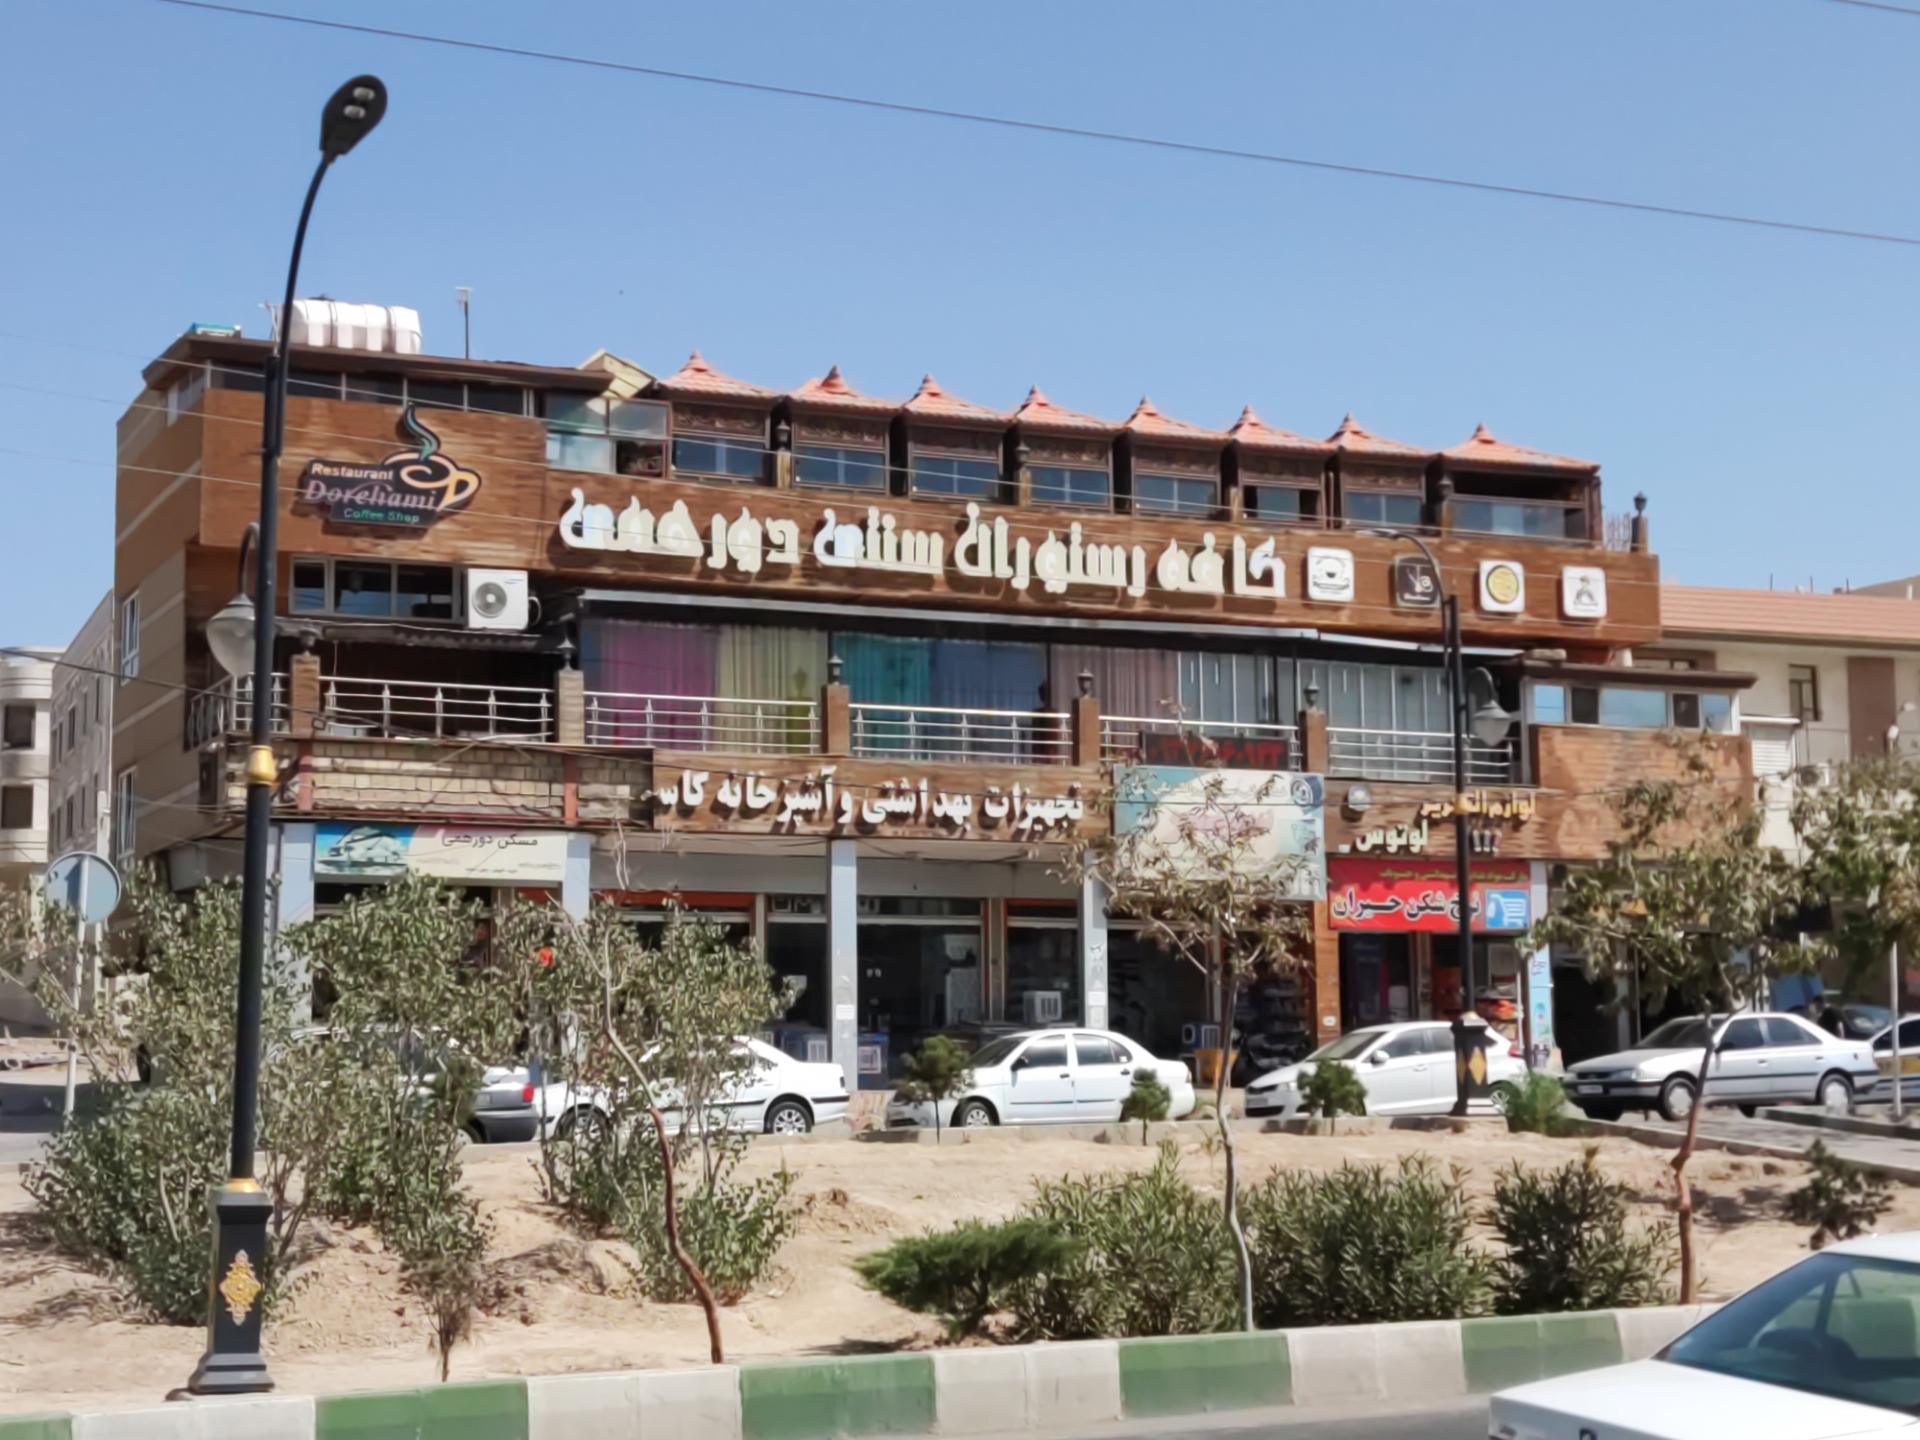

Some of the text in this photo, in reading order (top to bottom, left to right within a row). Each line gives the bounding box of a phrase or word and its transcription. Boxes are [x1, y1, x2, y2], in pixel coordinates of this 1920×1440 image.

[311, 463, 394, 480] Restaurant
[305, 479, 437, 511] Dorehami
[343, 508, 420, 523] Coffee Shop
[954, 501, 1146, 598] رستوران
[1157, 531, 1286, 599] کافه
[717, 764, 837, 827] آشپزخانه
[838, 789, 852, 824] و
[862, 777, 973, 832] بهداشتی
[984, 781, 1084, 832] تجهیزات
[1488, 789, 1536, 822] لوازم
[496, 832, 539, 850] مسکن
[1355, 818, 1429, 853] لوتوس
